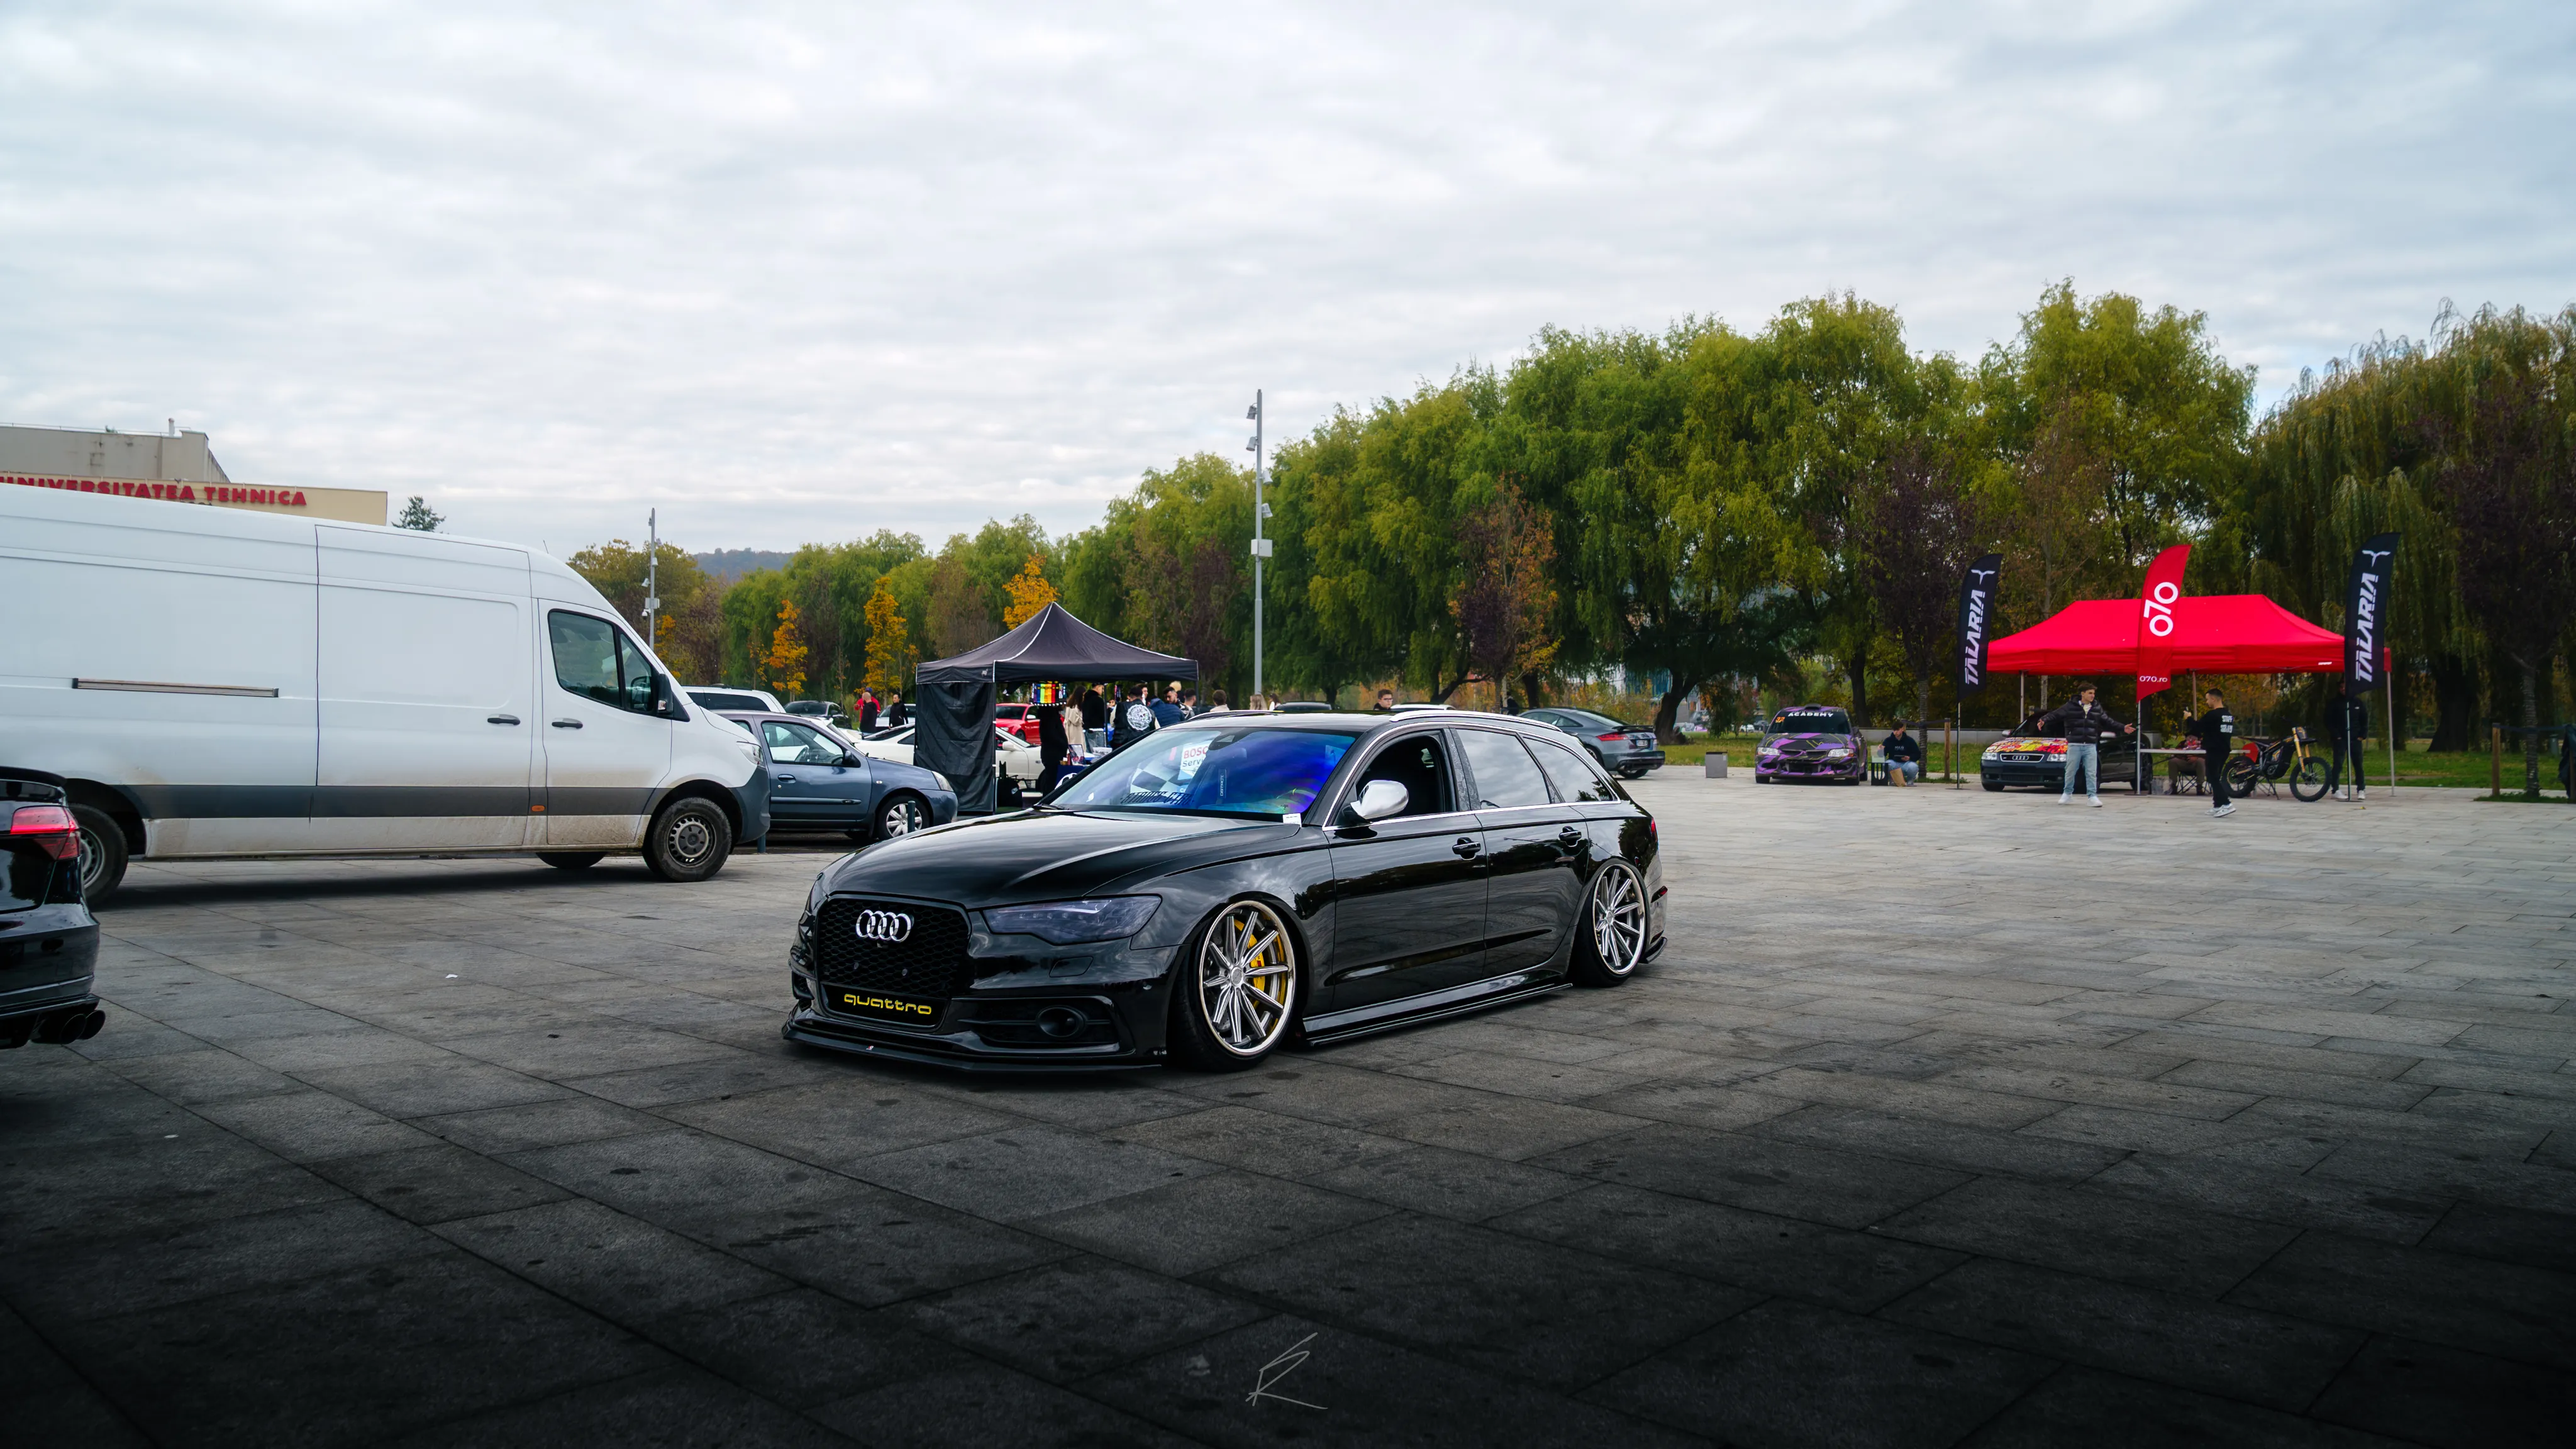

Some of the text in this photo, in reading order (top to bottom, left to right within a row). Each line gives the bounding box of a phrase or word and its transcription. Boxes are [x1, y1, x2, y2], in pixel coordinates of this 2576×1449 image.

[204, 487, 307, 506] TEHNICA
[1965, 589, 1985, 686] TALARIA
[2355, 572, 2379, 682] TALARIA
[844, 994, 931, 1014] quattro
